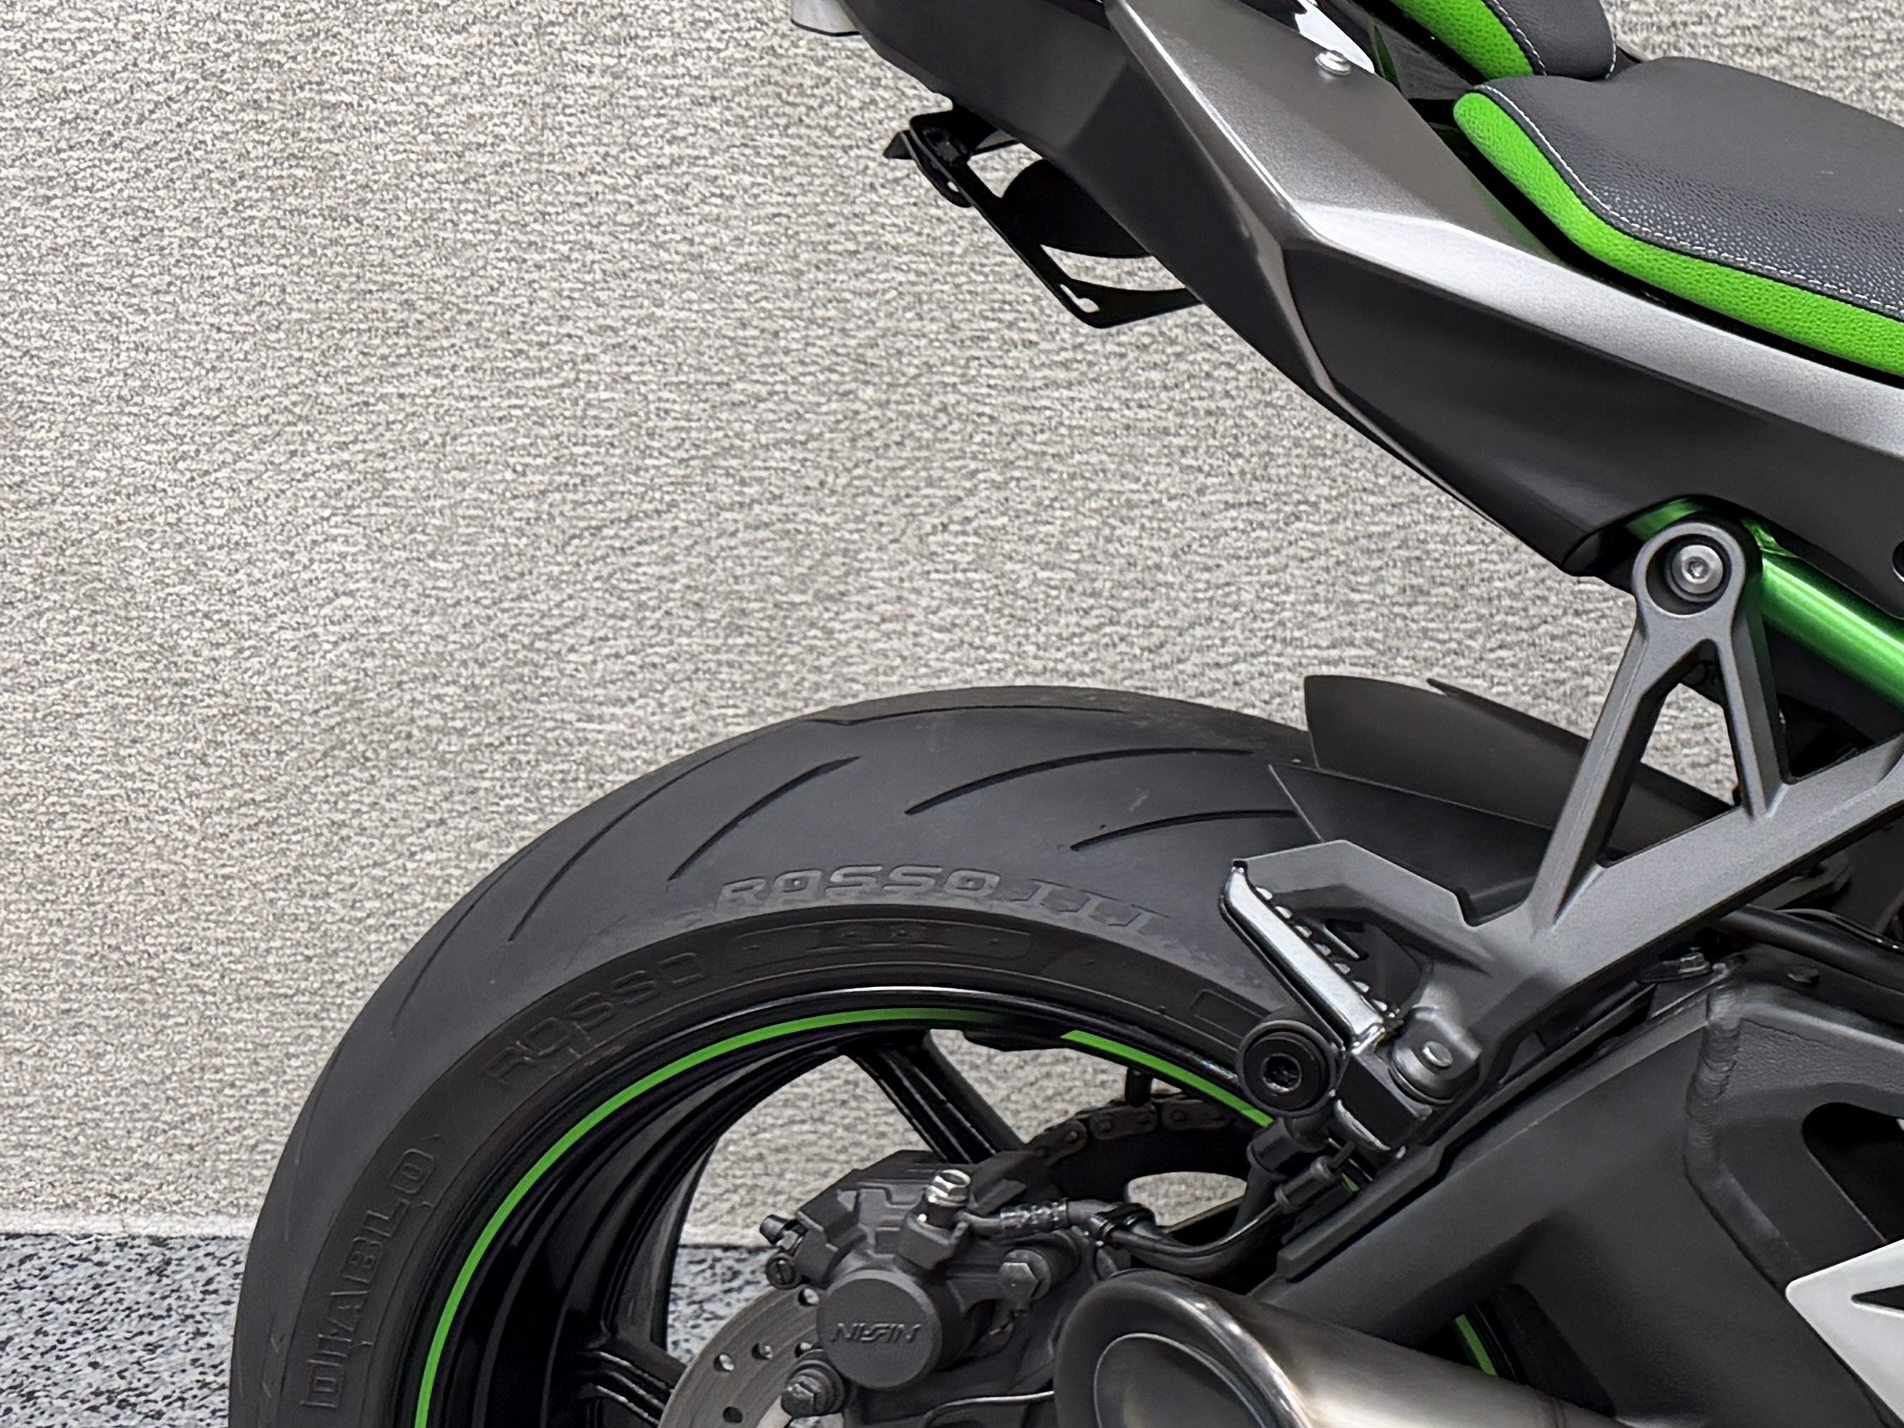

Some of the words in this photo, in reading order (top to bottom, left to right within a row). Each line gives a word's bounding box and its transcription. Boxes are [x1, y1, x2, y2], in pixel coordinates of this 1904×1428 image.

[715, 863, 997, 912] ROSSO
[481, 945, 702, 1095] ROSSO
[300, 1145, 433, 1412] DIABLO
